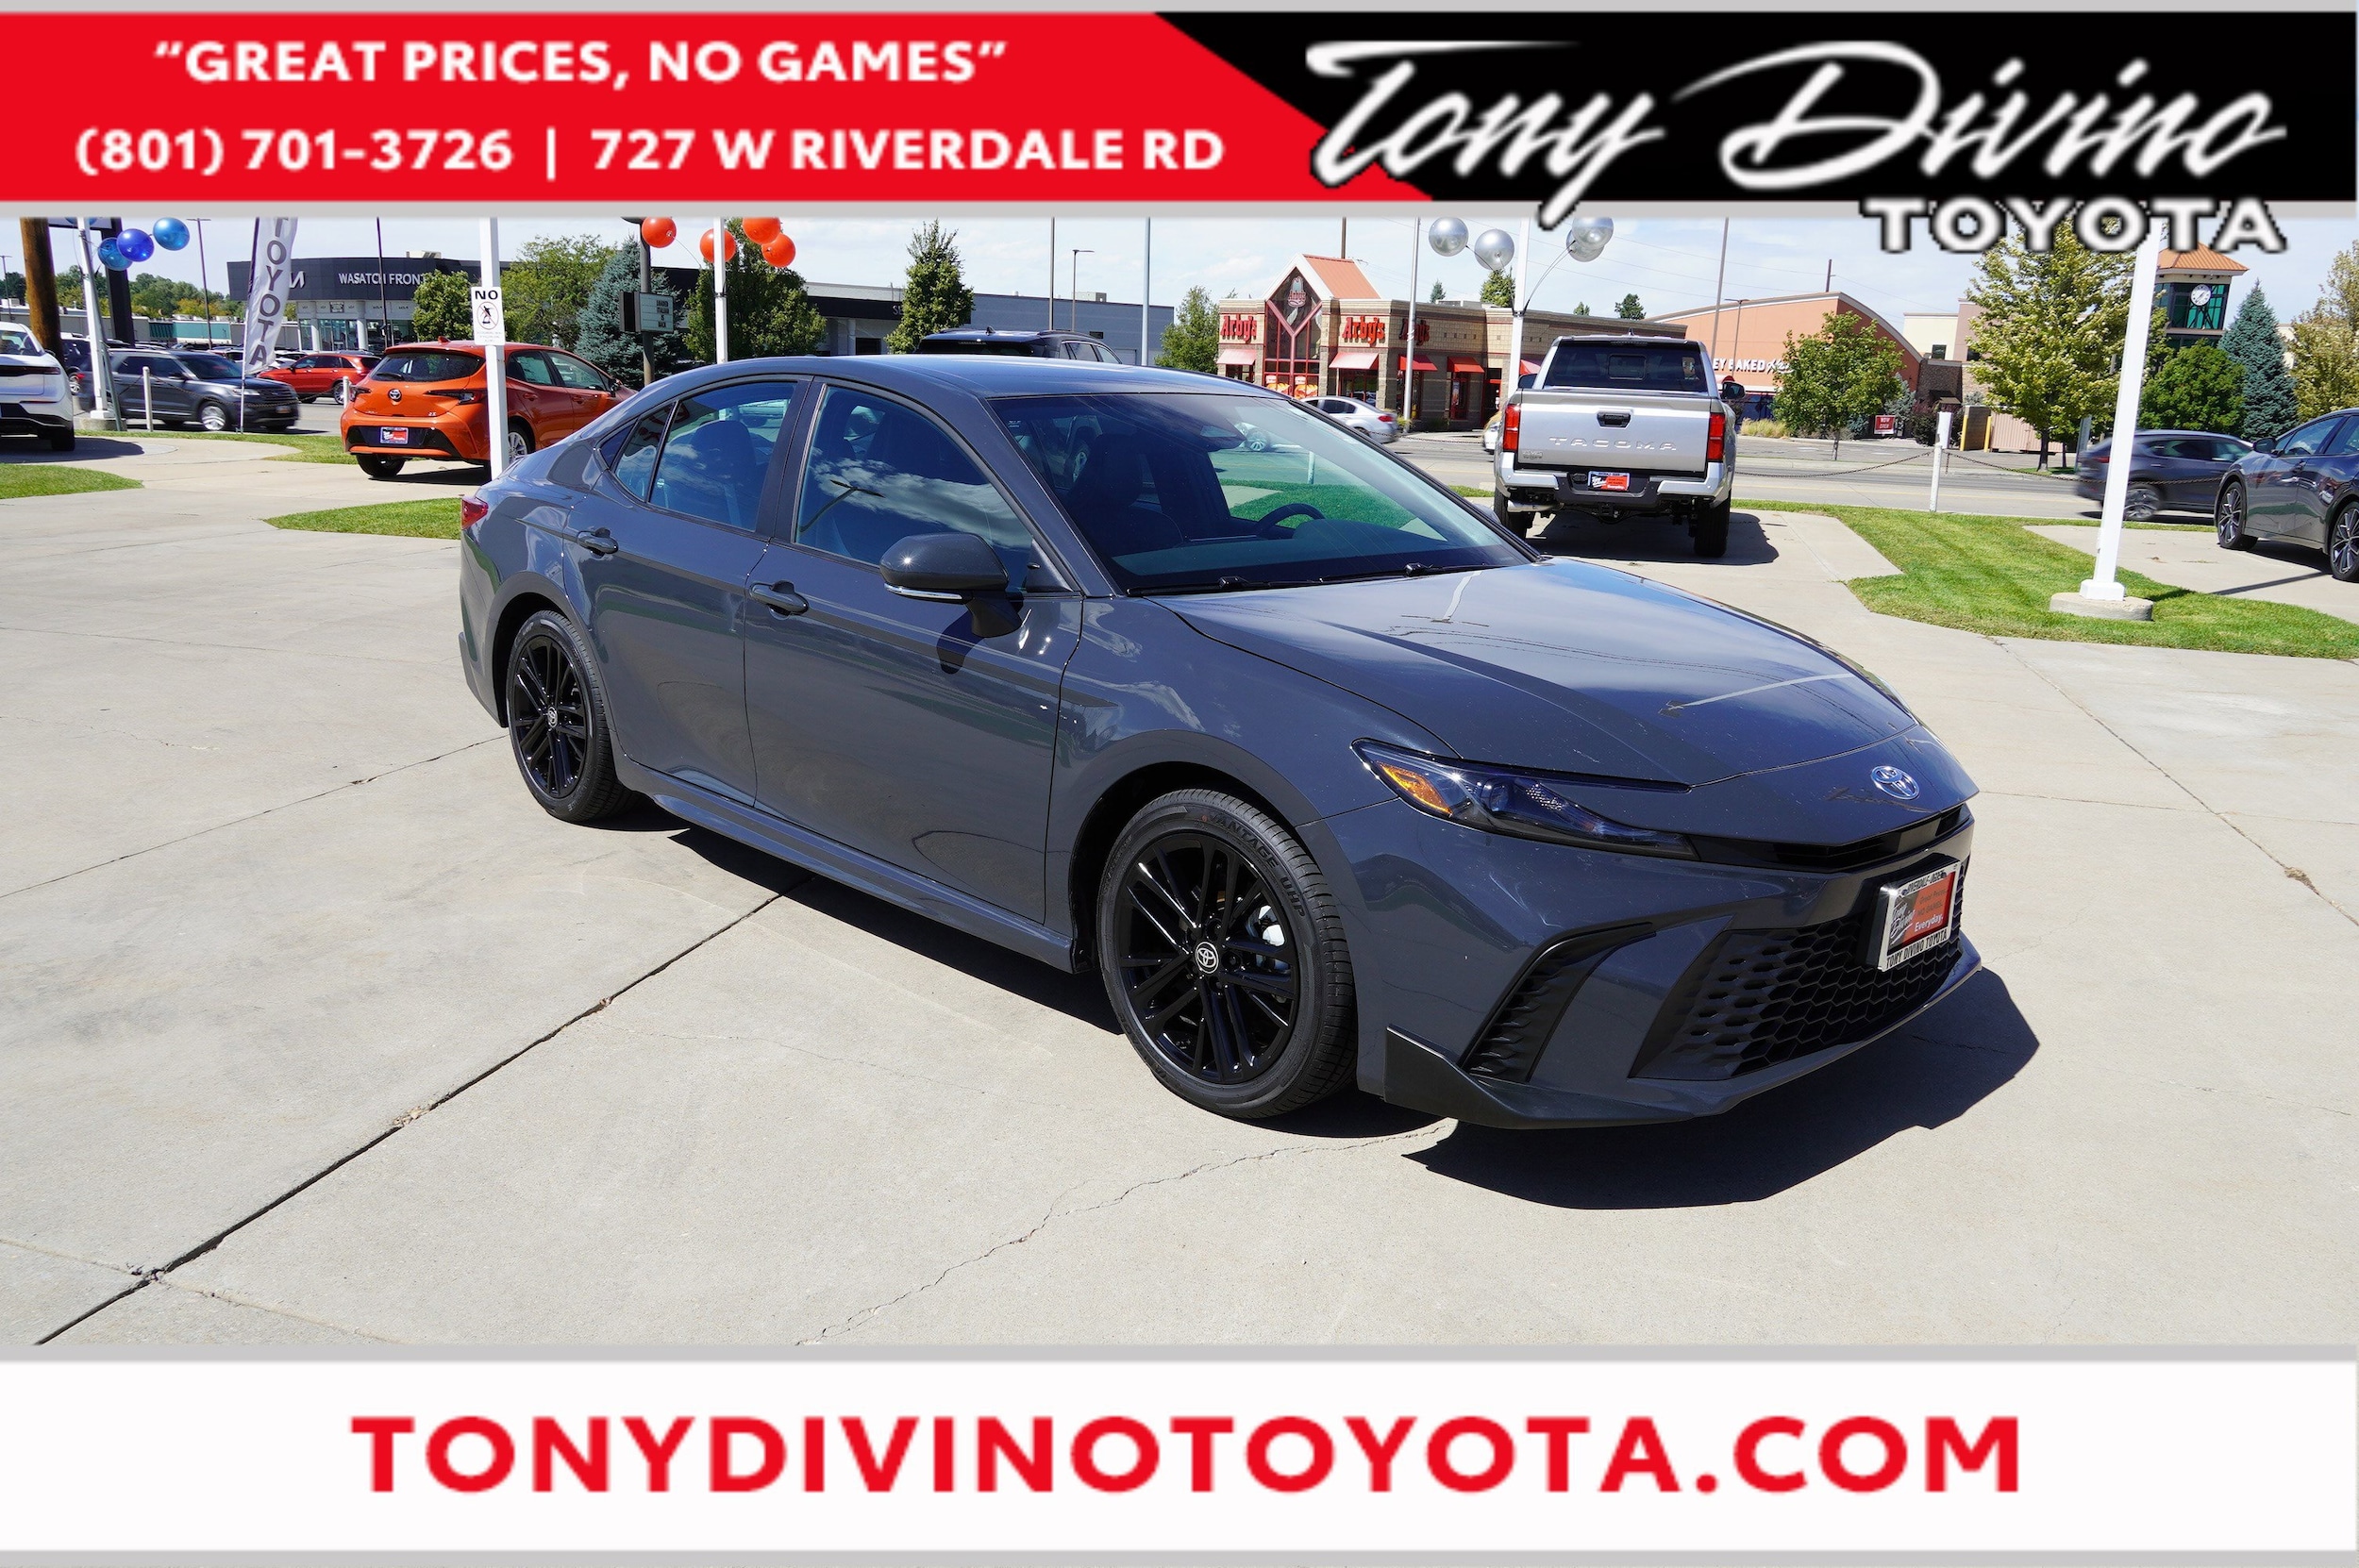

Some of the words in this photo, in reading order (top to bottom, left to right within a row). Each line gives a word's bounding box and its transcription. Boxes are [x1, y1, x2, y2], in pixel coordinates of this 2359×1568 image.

[475, 290, 499, 300] NO
[1220, 313, 1257, 341] Arby's
[1342, 315, 1385, 344] Arby's
[1548, 436, 1678, 452] TACOMA
[1925, 927, 1949, 949] TOYOTA
